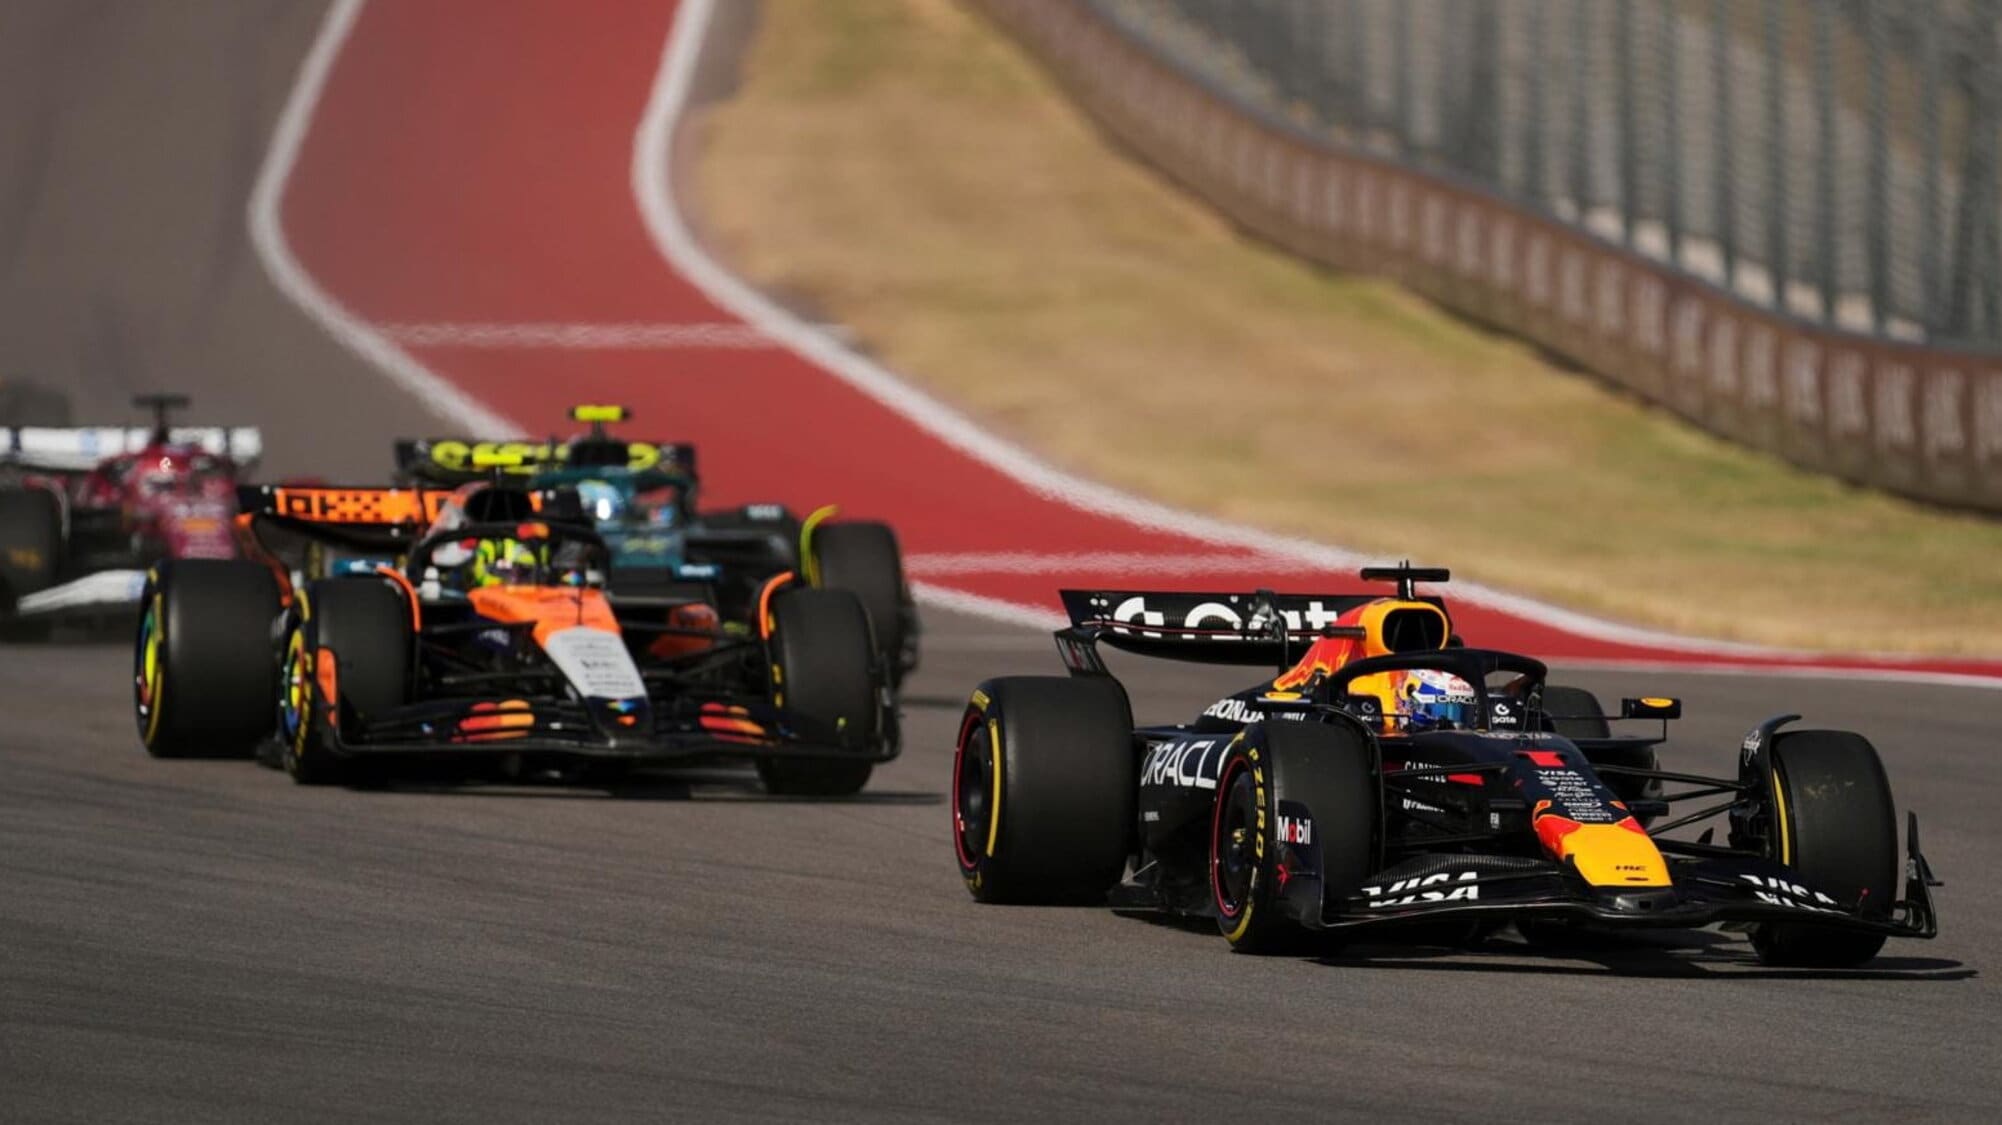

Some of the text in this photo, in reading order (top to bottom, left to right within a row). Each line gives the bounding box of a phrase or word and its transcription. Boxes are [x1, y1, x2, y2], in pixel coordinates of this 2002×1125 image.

[1436, 694, 1478, 705] ORACL
[1140, 740, 1233, 790] ORACL
[1276, 815, 1312, 845] Mobil
[1360, 871, 1479, 908] VISA
